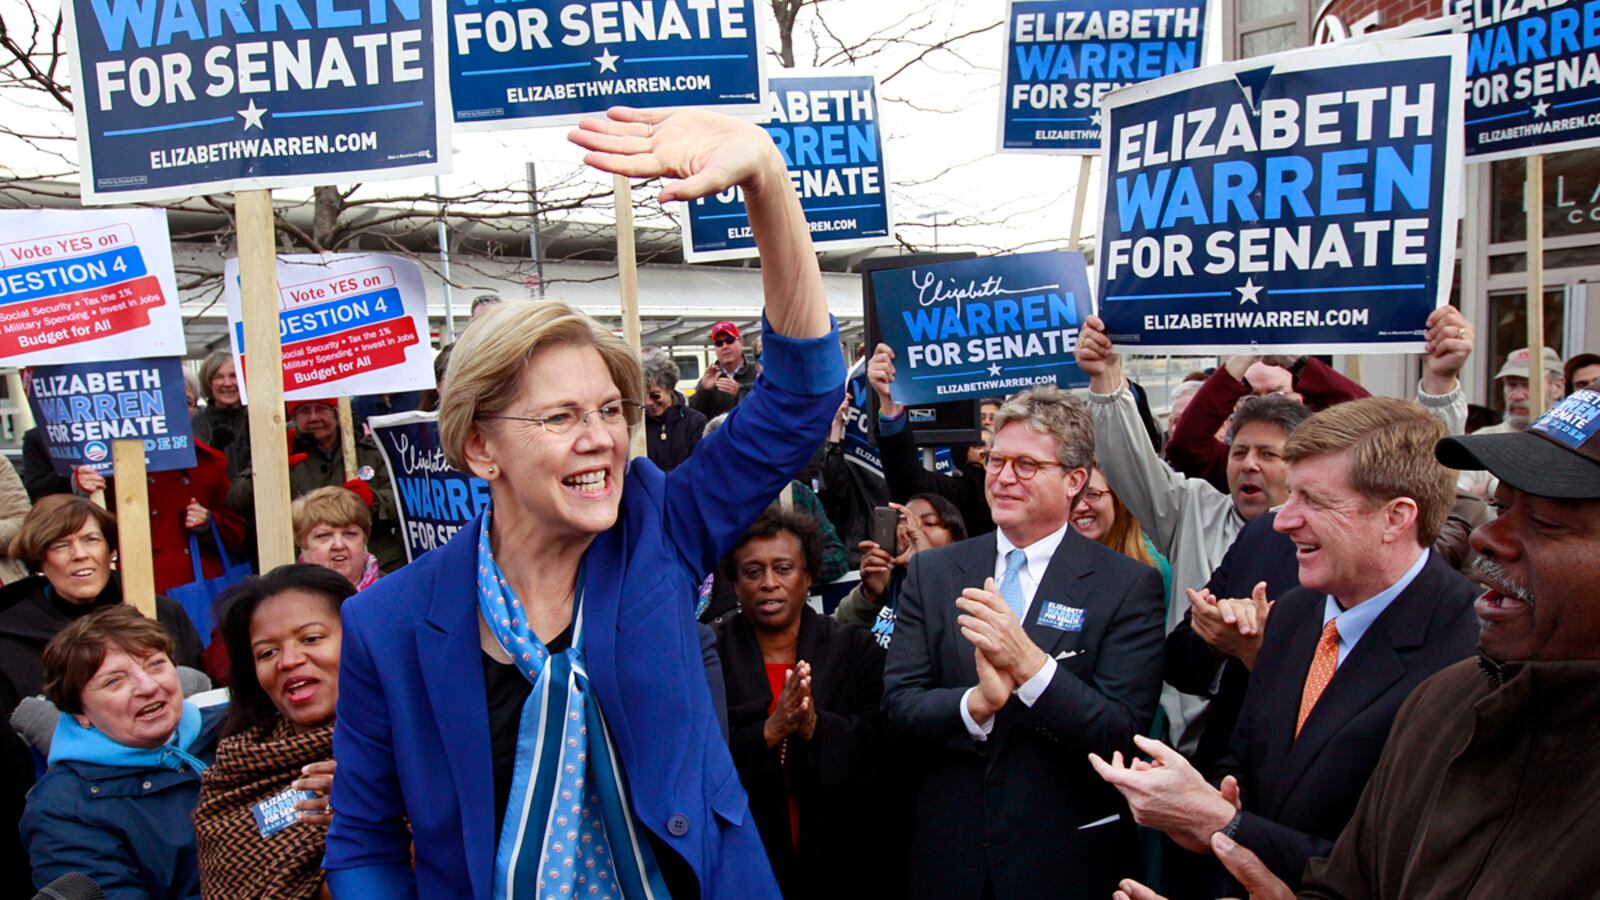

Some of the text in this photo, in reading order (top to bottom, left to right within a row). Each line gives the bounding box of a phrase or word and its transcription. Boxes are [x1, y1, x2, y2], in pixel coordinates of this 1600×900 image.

[453, 0, 749, 55] FOR SENATE
[1015, 7, 1200, 43] ELIZABETH
[1467, 0, 1600, 76] WARRE
[95, 29, 424, 111] FOR SENATE
[1015, 41, 1196, 81] WARREN
[1513, 52, 1600, 100] SENA
[507, 74, 711, 104] ELIZABETHWARREN.COM
[1012, 83, 1068, 110] FOR
[768, 89, 874, 124] ABETH
[1117, 83, 1436, 173] ELIZABETH
[1478, 113, 1600, 144] ELIZABETHWARREN.CO
[150, 131, 378, 169] ELIZABETHWARREN.COM
[768, 124, 878, 166] RREN
[791, 166, 881, 198] ENATE
[1116, 143, 1433, 233] WARREN
[10, 233, 119, 261] Vote YES on
[1107, 217, 1430, 281] FOR SENATE
[113, 255, 128, 273] 4
[31, 302, 72, 315] Security
[82, 297, 100, 306] Tax
[100, 293, 117, 301] the
[290, 274, 382, 304] Vote YES on
[374, 296, 389, 313] 4
[3, 293, 161, 334] Military Spending Invest in Jobs
[902, 291, 1078, 343] WARREN
[1144, 308, 1369, 331] ELIZABETHWARREN.COM
[17, 319, 113, 347] Budget for All
[305, 340, 340, 354] Security
[348, 334, 362, 344] Tax
[363, 331, 377, 340] the
[315, 347, 354, 364] Spending
[360, 338, 387, 351] Invest
[387, 336, 396, 345] in
[396, 332, 416, 344] Jobs
[907, 328, 1079, 369] FOR SENATE
[32, 368, 162, 398] ELIZABETH
[294, 355, 372, 383] Budget for All
[936, 374, 1057, 395] ELIZABETHWARREN.COM
[38, 389, 165, 425] WARREN
[46, 415, 168, 443] FOR SENATE
[407, 520, 437, 550] FOR
